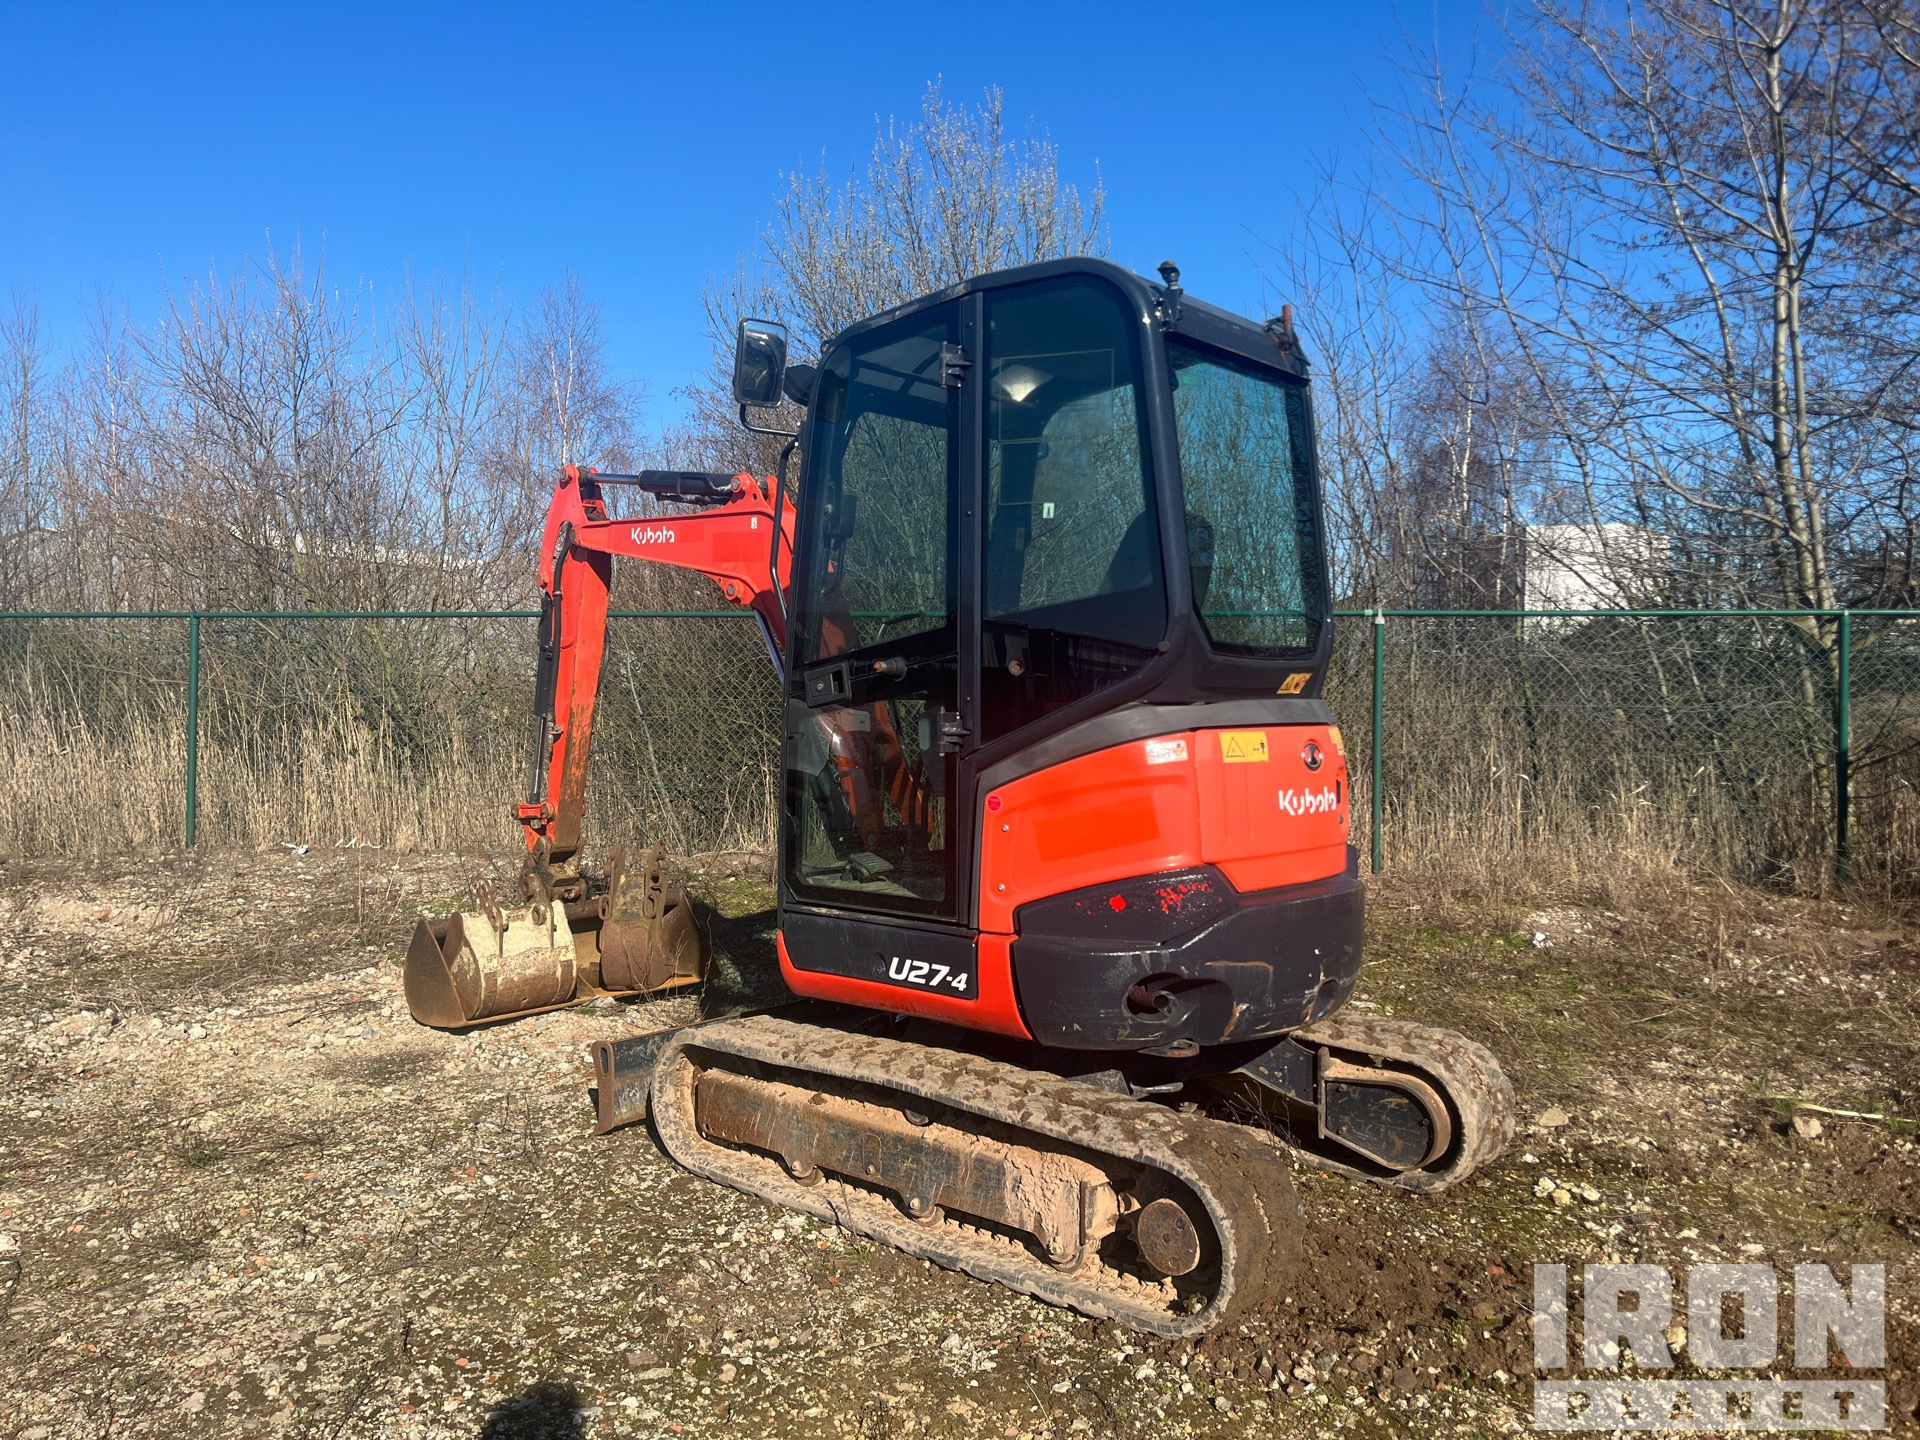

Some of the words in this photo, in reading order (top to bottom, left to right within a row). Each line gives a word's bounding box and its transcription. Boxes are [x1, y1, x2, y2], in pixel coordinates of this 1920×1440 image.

[631, 525, 675, 545] Kubota
[1277, 785, 1337, 816] Kubota
[888, 956, 968, 992] U27-4
